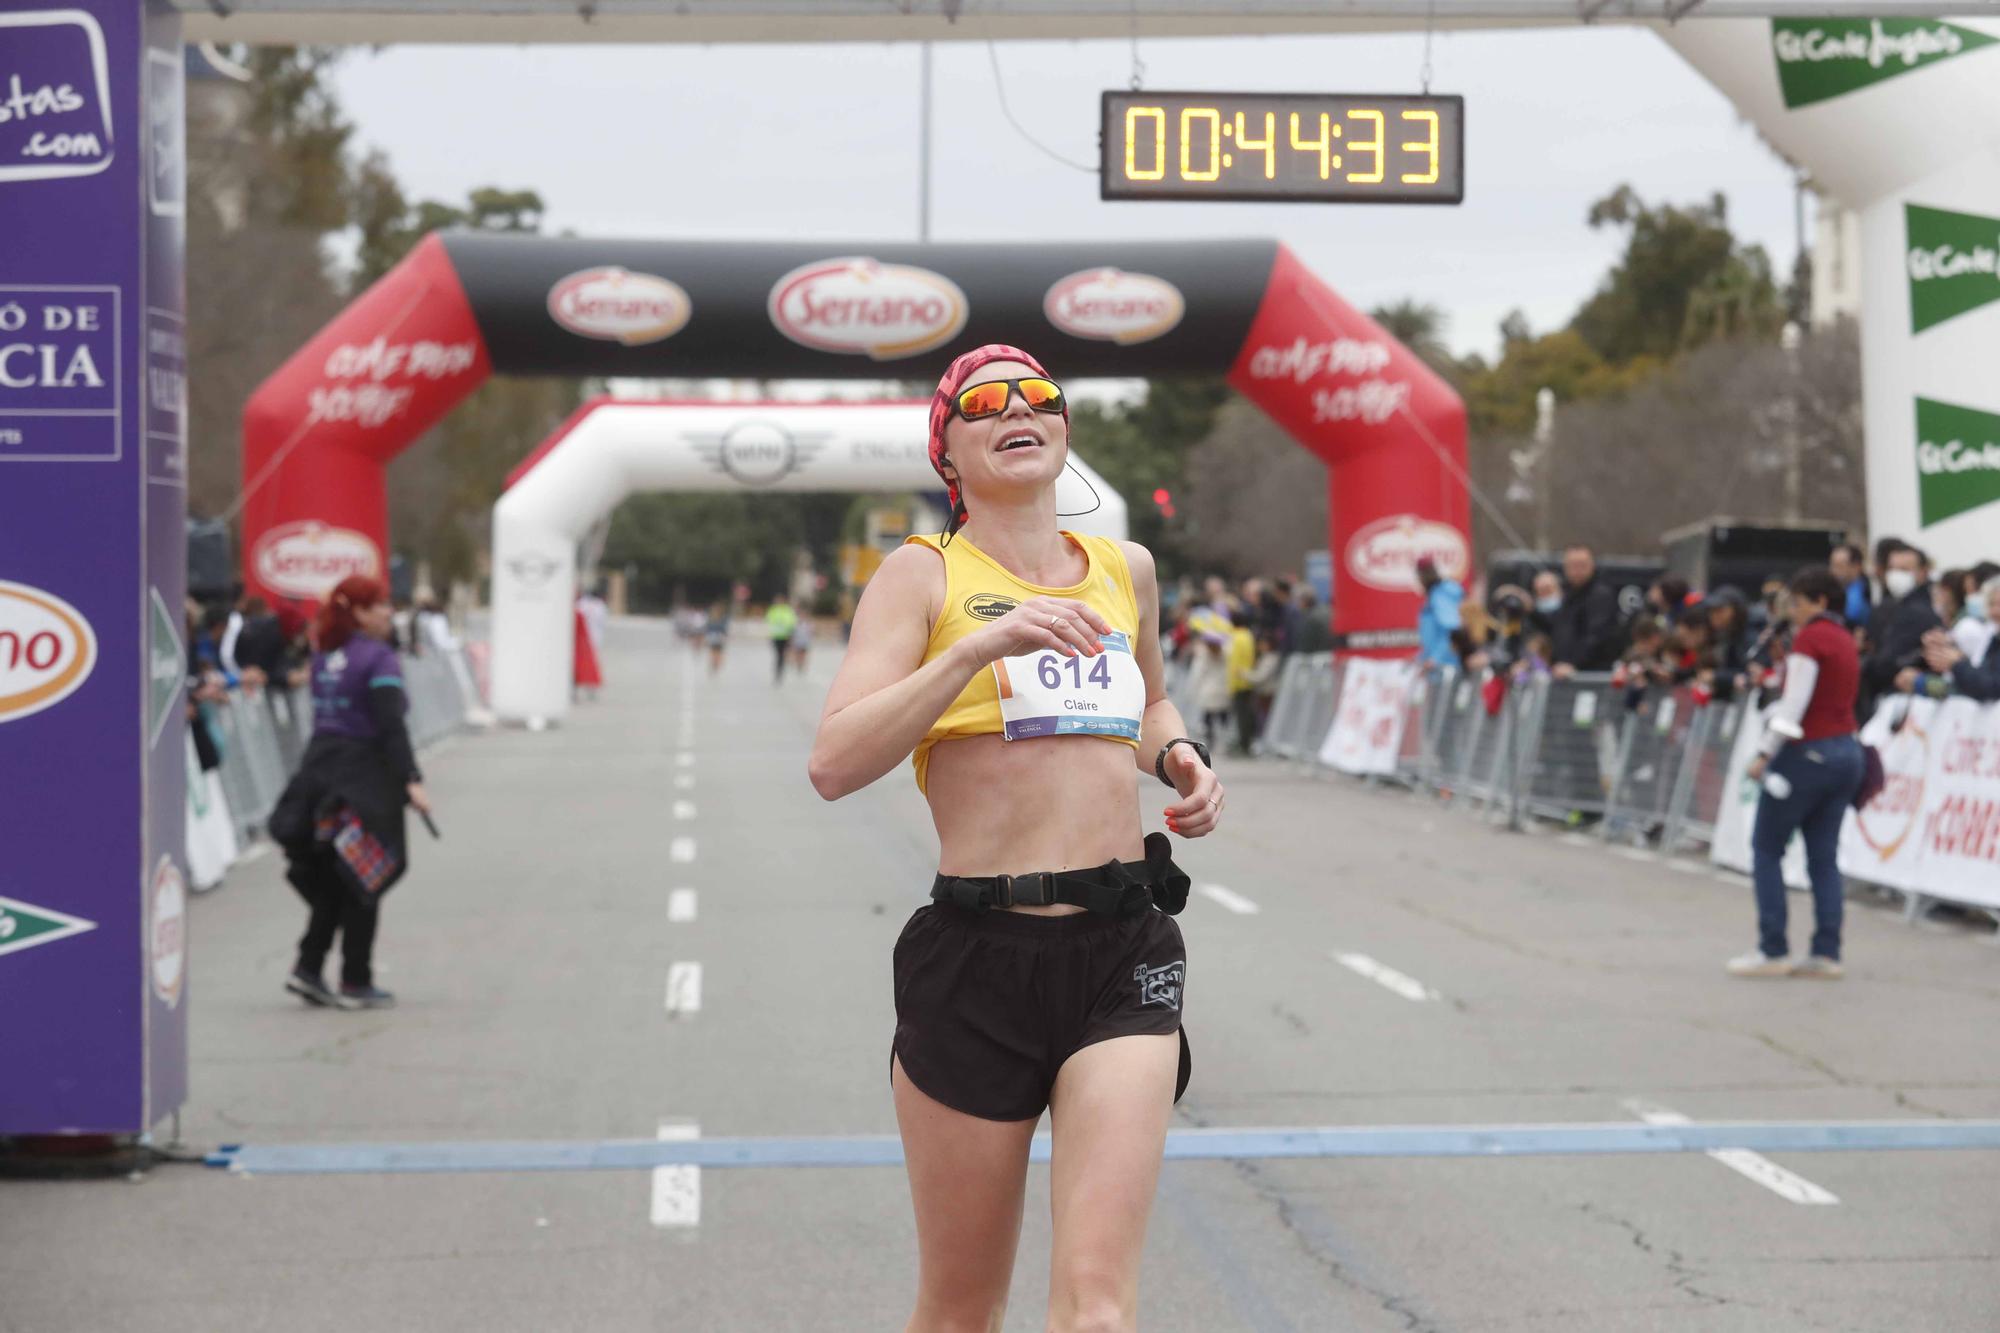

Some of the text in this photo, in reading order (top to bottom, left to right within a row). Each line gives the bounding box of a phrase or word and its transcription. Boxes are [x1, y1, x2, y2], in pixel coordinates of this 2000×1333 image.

[21, 131, 101, 157] .com
[1125, 107, 1438, 184] 00:44:33
[43, 305, 100, 331] DE
[569, 290, 674, 320] Serrano
[798, 288, 945, 328] Serrano
[1037, 654, 1112, 690] 614
[1064, 699, 1098, 711] Claire
[1135, 967, 1147, 976] 20
